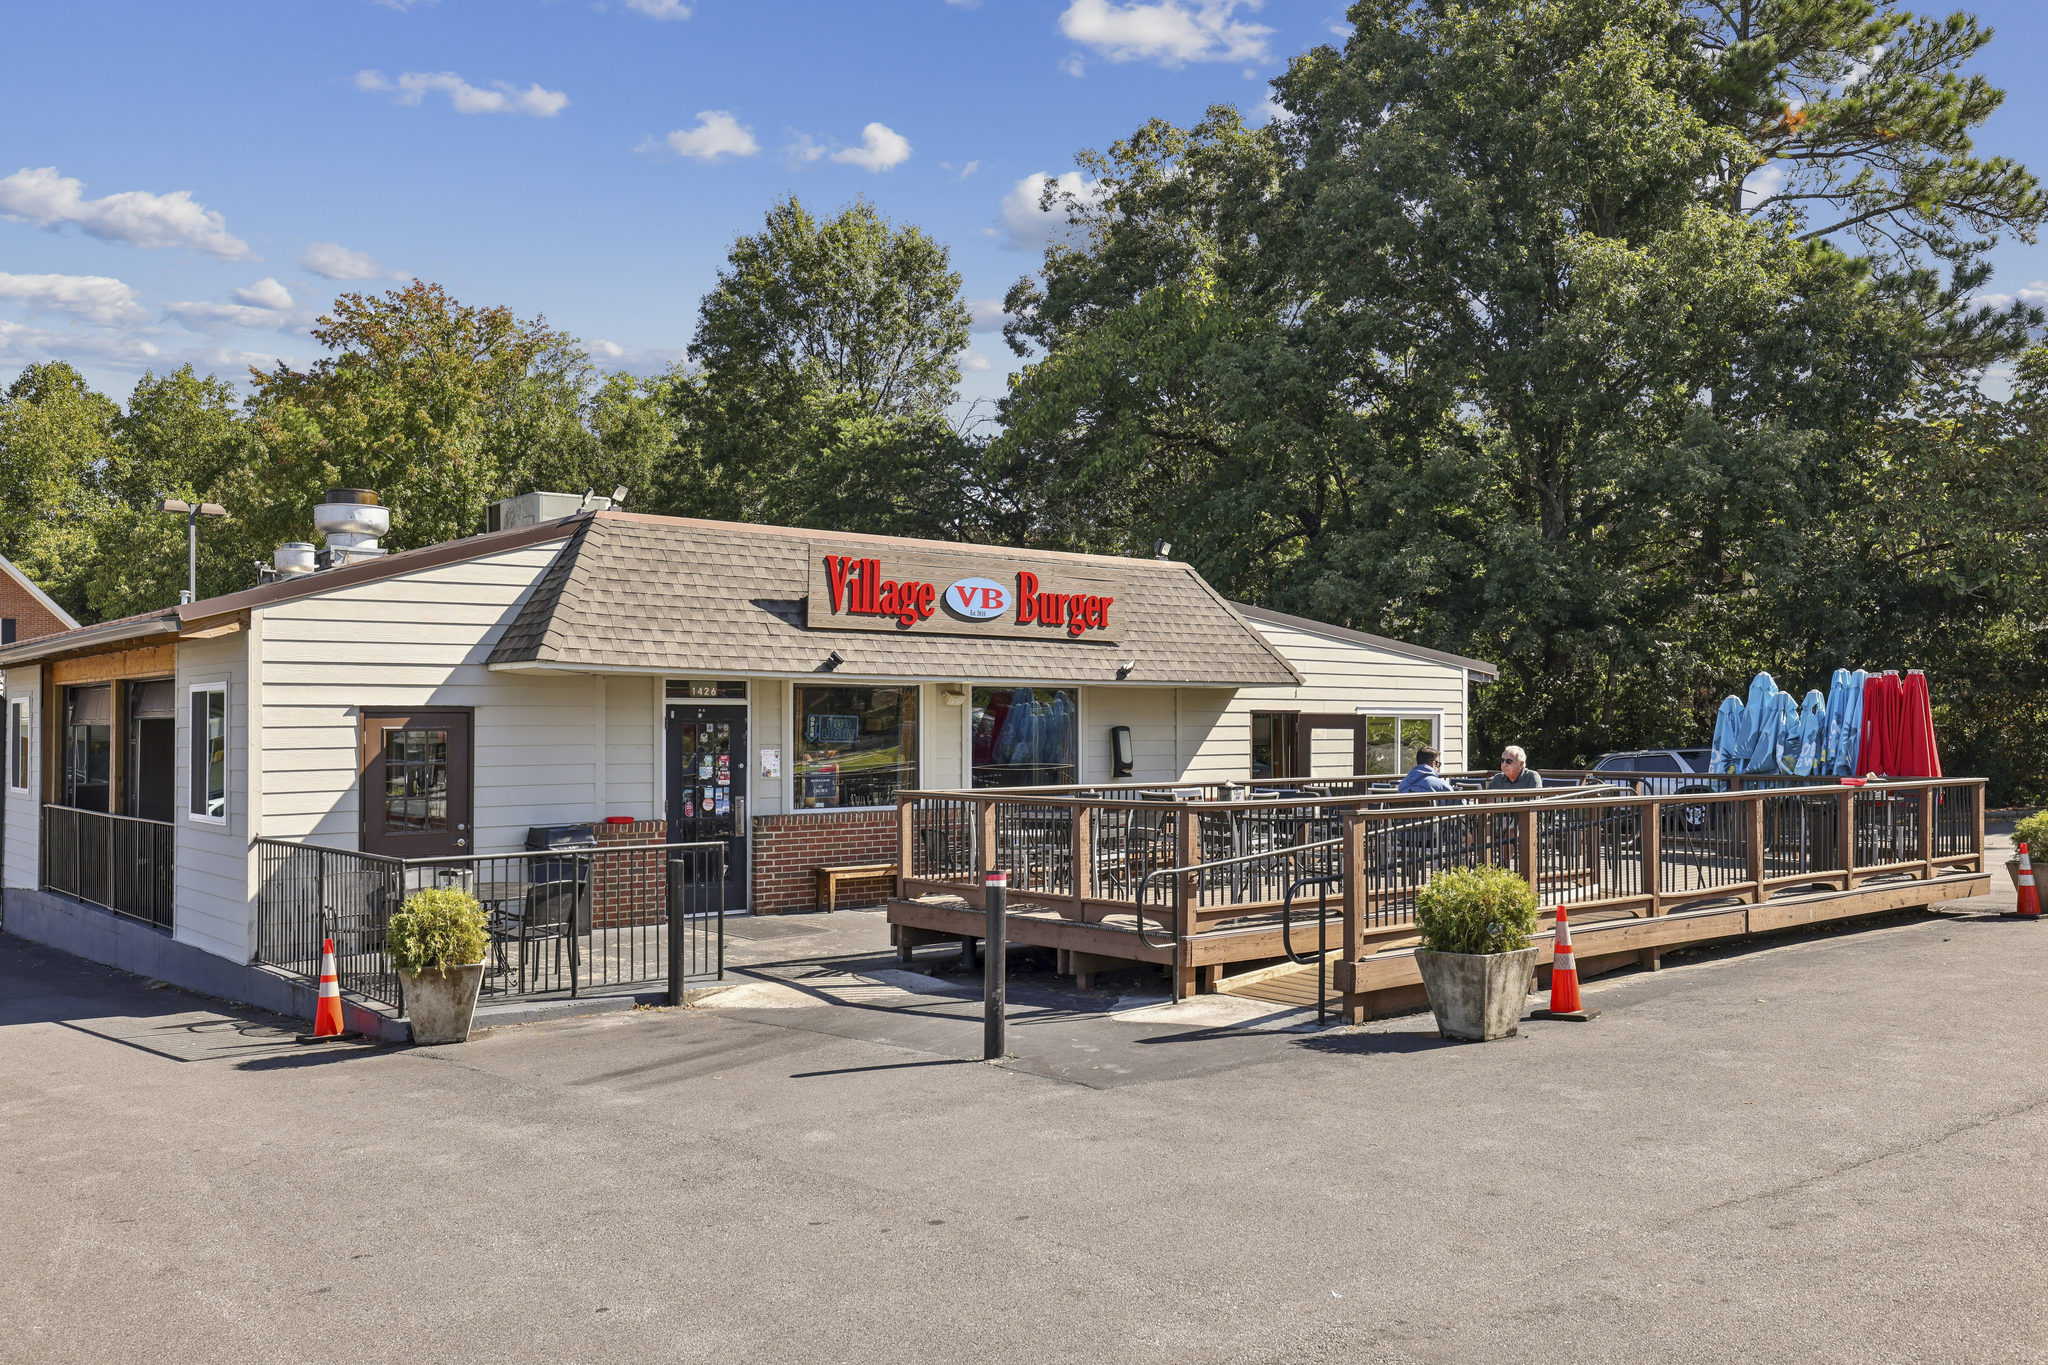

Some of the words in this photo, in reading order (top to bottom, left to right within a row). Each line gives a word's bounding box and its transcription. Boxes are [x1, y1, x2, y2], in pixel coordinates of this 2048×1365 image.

[825, 555, 936, 626] Village
[954, 585, 1004, 609] VB
[1018, 571, 1114, 635] Burger
[692, 687, 716, 696] 1426
[827, 718, 852, 729] BUD
[822, 728, 856, 740] LIGHT
